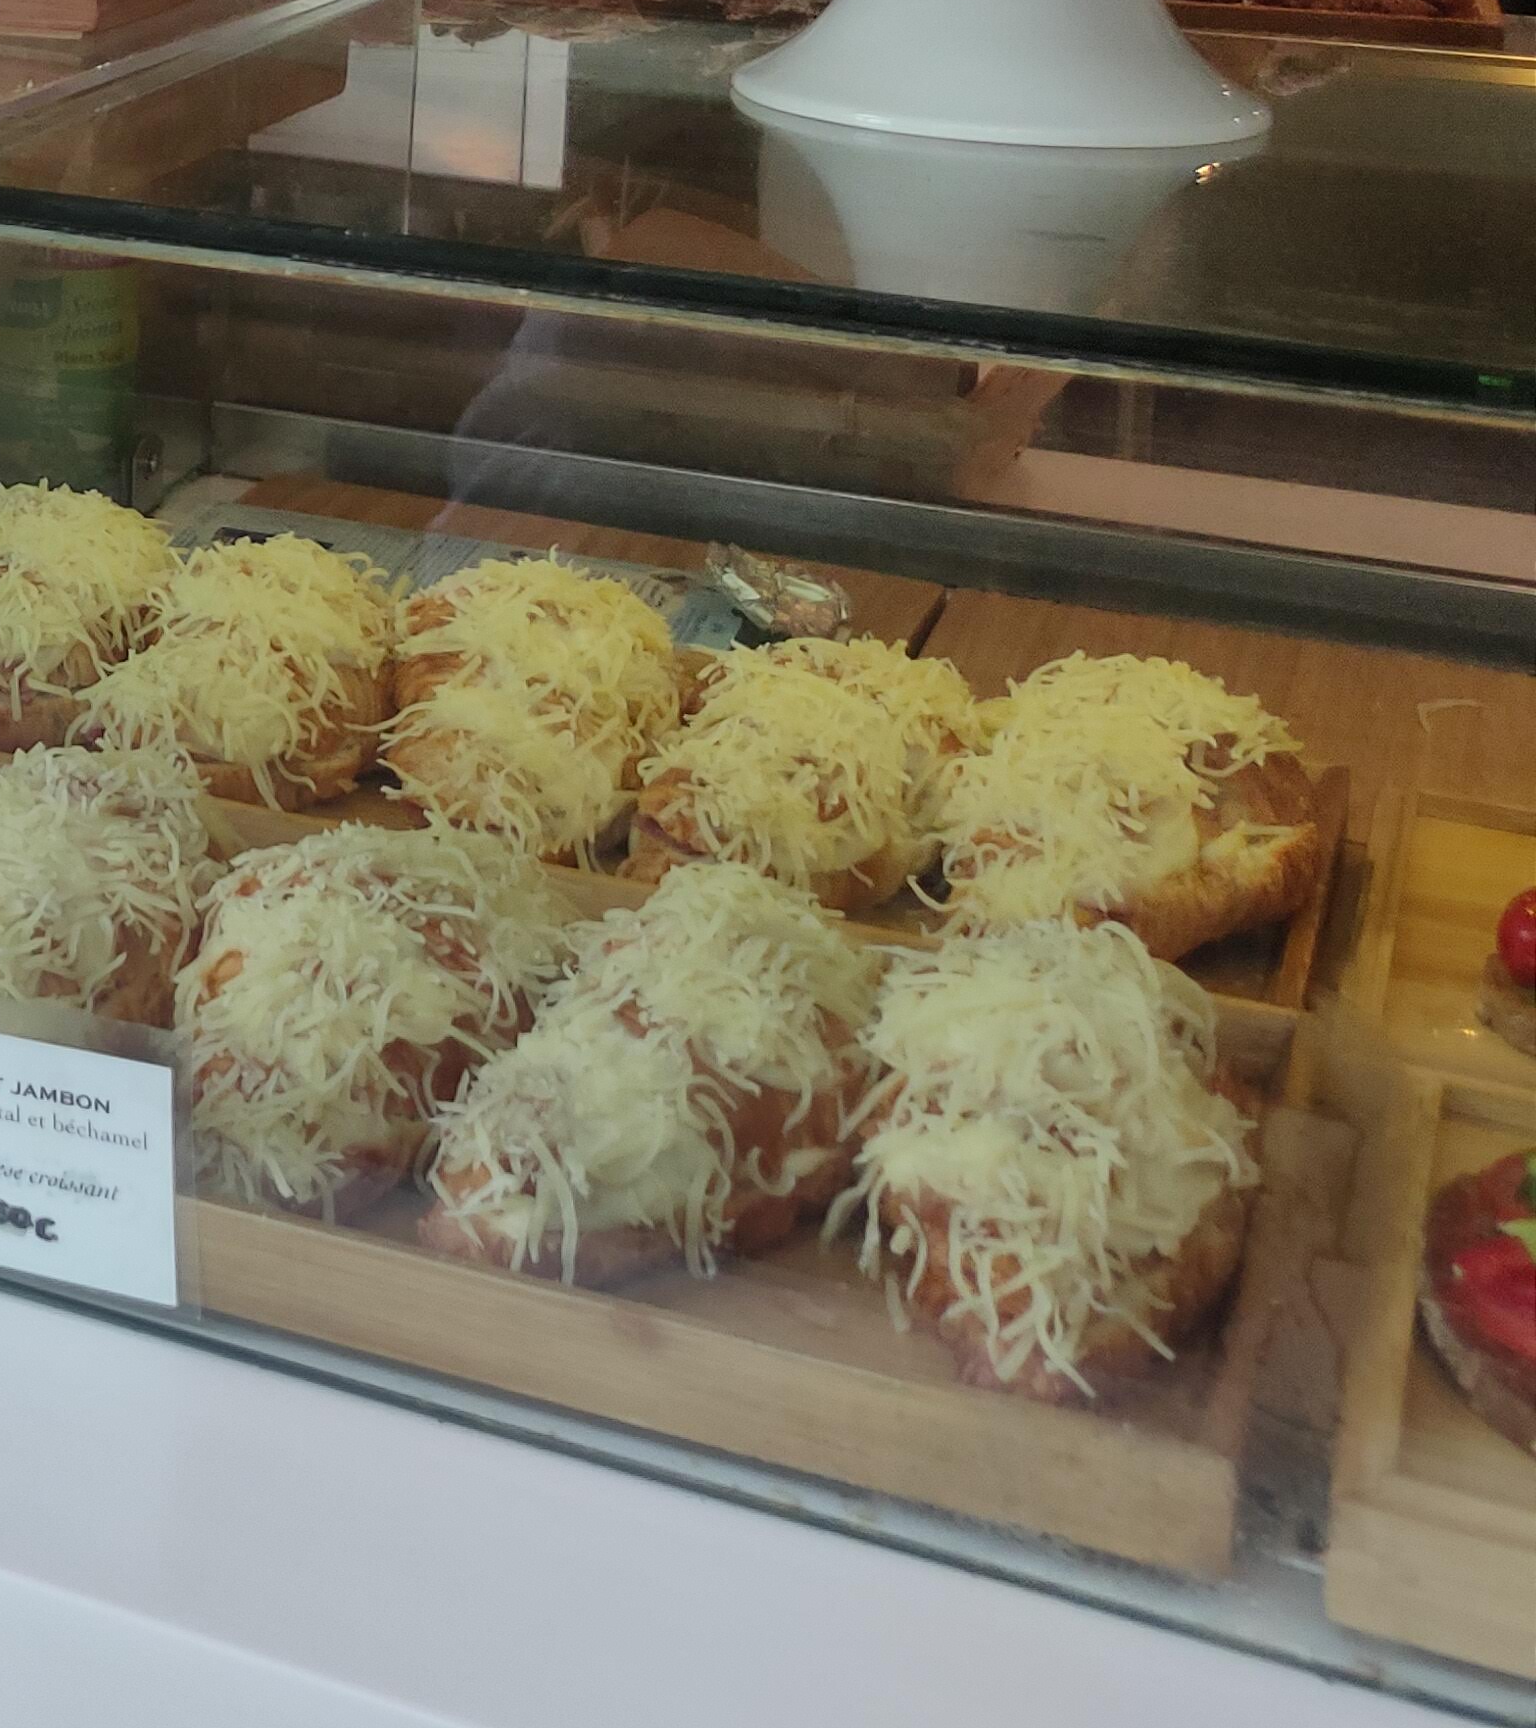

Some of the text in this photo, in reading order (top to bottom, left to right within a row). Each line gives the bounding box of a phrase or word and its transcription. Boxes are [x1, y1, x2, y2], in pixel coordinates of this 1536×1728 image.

[10, 1079, 112, 1115] JAMBON
[27, 1112, 46, 1130] et
[52, 1112, 149, 1152] béchamel
[28, 1169, 121, 1203] croissant
